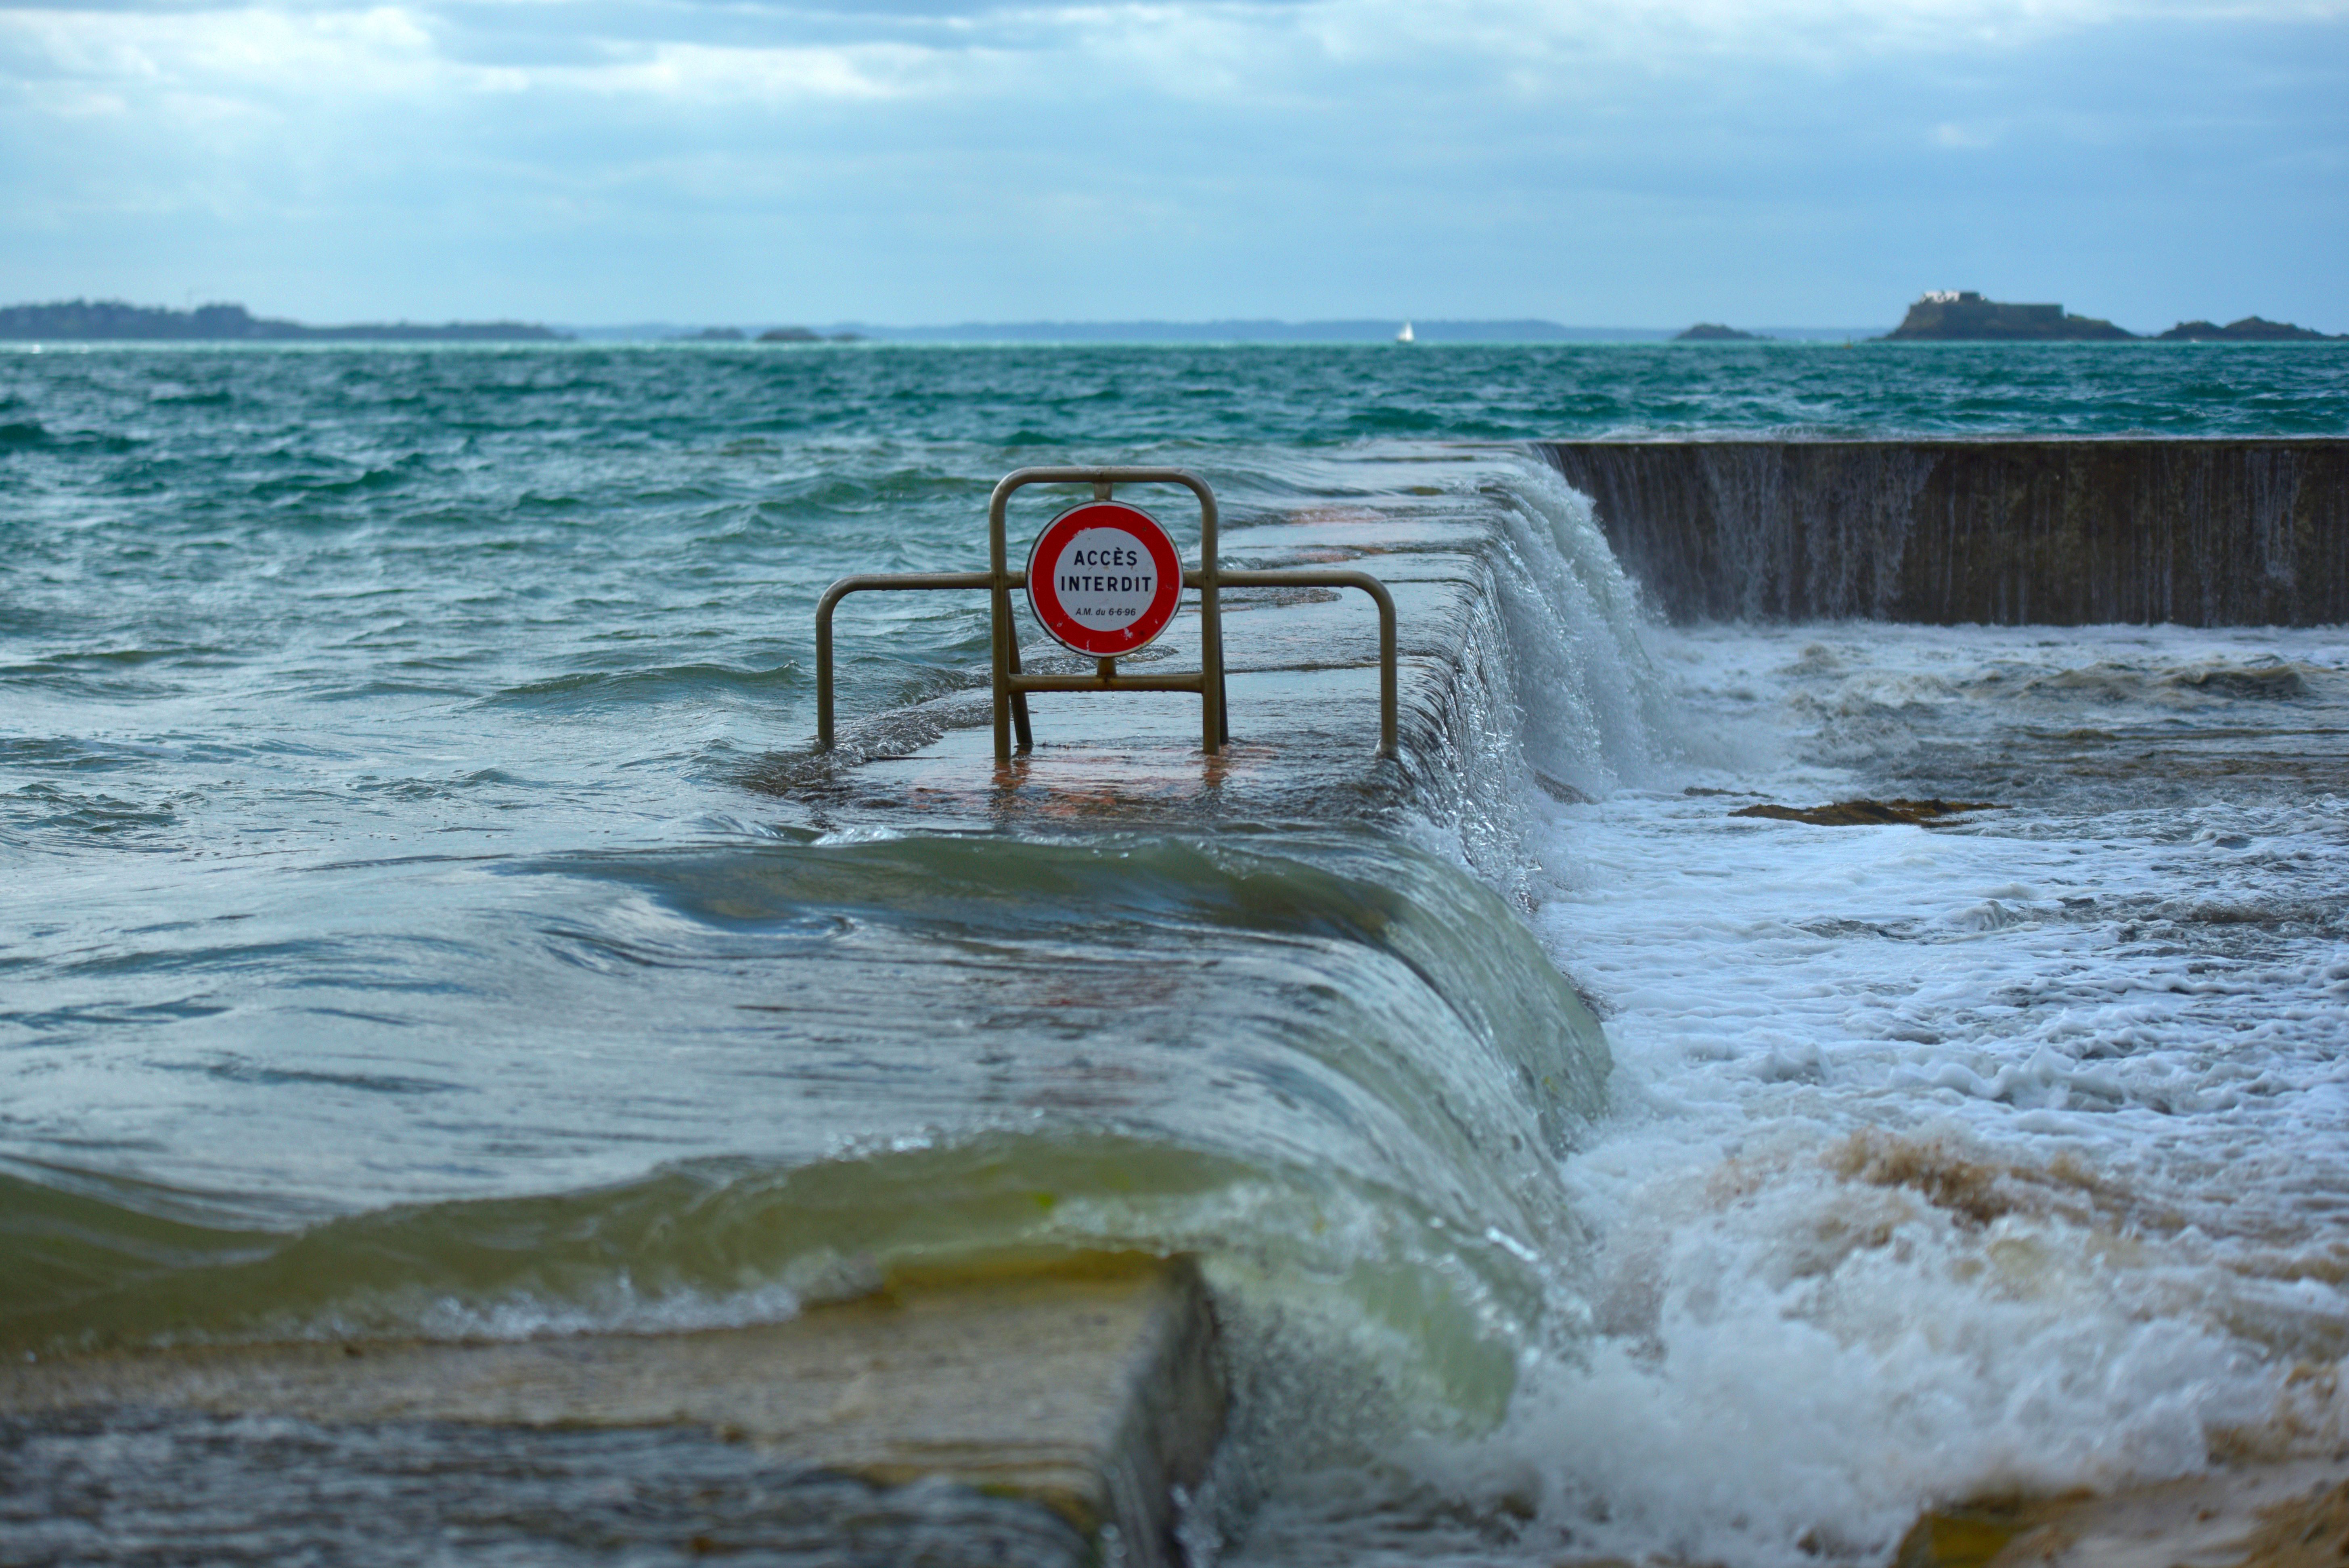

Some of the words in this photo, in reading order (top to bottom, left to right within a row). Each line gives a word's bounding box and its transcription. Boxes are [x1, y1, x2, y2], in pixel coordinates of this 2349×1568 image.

[1074, 547, 1138, 566] ACCÈS
[1061, 576, 1152, 592] INTERDIT
[1075, 608, 1093, 616] A.M.
[1095, 608, 1105, 616] du
[1109, 608, 1136, 616] 6-6-96
